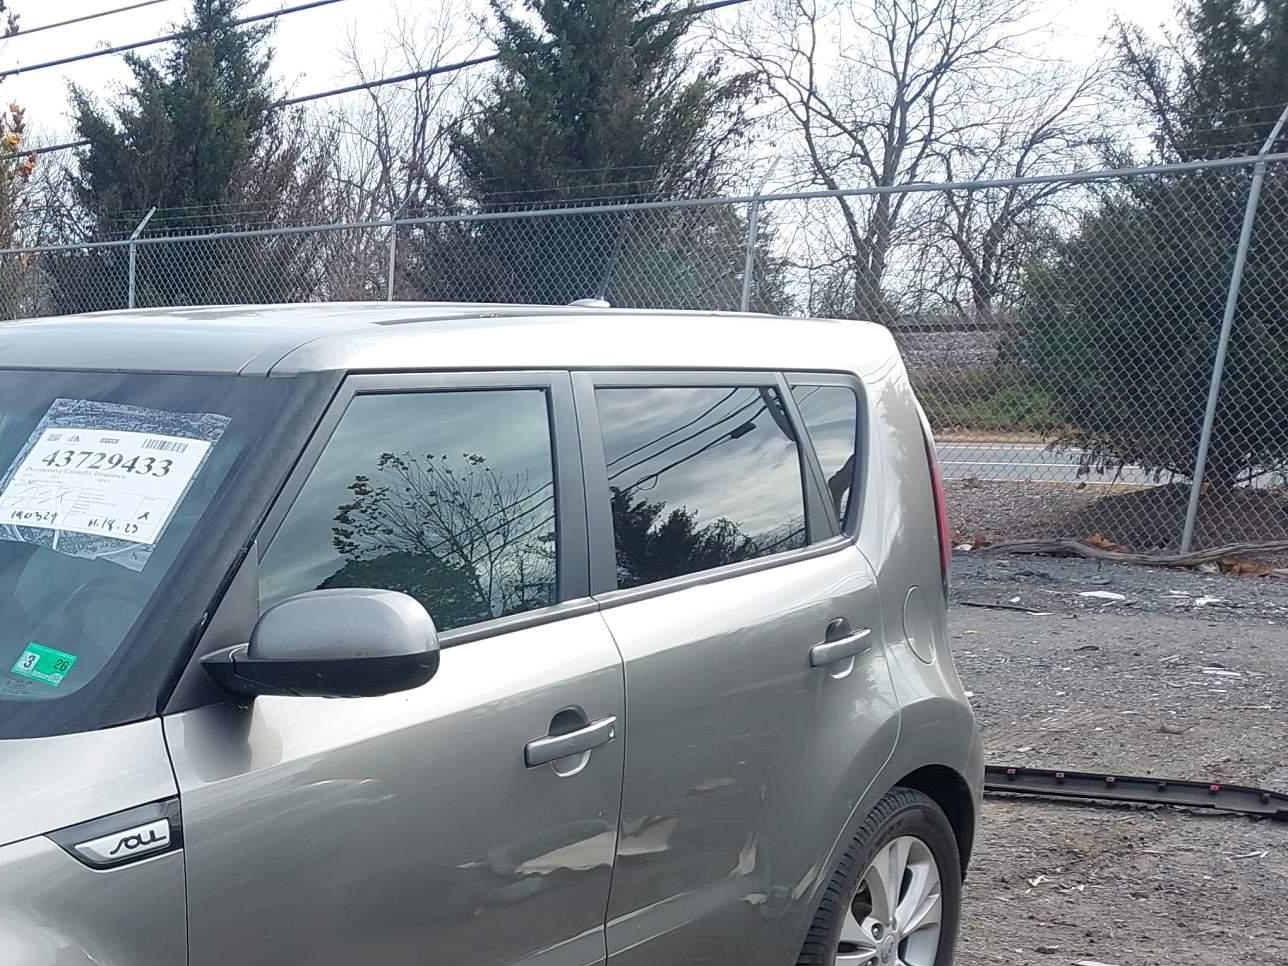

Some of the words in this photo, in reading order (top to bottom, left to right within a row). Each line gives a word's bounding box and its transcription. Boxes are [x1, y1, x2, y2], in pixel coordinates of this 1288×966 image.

[42, 449, 174, 477] 43729433
[23, 655, 36, 668] 3
[52, 658, 70, 672] 26
